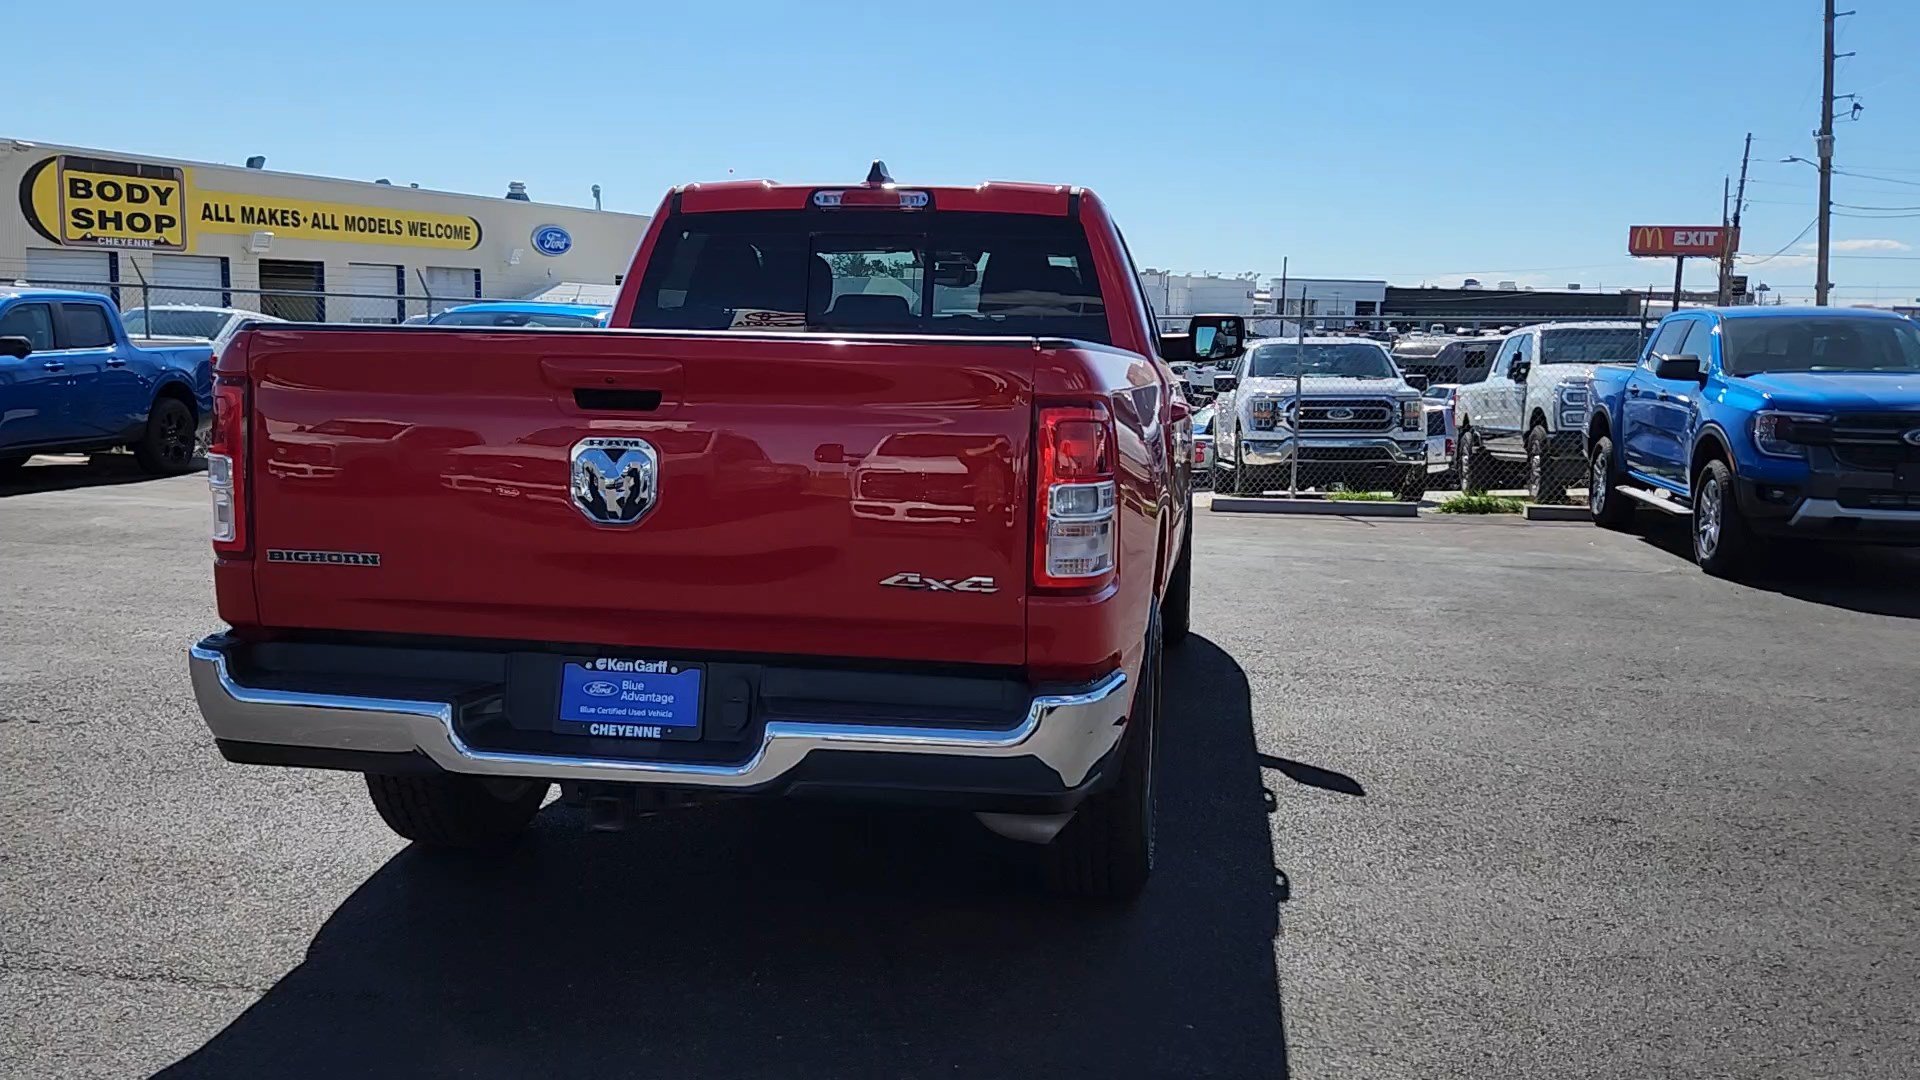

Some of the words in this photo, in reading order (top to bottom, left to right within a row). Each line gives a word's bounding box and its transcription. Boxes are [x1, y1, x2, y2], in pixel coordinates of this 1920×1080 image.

[68, 177, 175, 206] BODY
[71, 207, 177, 234] SHOP
[201, 203, 236, 223] ALL
[240, 206, 301, 228] MAKES
[311, 212, 340, 231] ALL
[344, 215, 403, 236] MODELS
[407, 220, 472, 241] WELCOME
[97, 236, 155, 248] CHEYENNE
[543, 231, 567, 250] Ford
[1673, 231, 1719, 246] EXIT
[589, 439, 640, 448] RAM
[266, 549, 380, 567] BIGHORN
[608, 658, 633, 672] Ken
[634, 660, 668, 674] Garff
[589, 682, 613, 694] Ford
[622, 680, 644, 691] Blue
[621, 691, 674, 704] Advantage
[580, 706, 596, 714] Blue
[597, 706, 626, 716] Certified
[628, 709, 646, 717] Used
[648, 709, 673, 718] Vehicle
[590, 723, 661, 738] CHEYENNE
